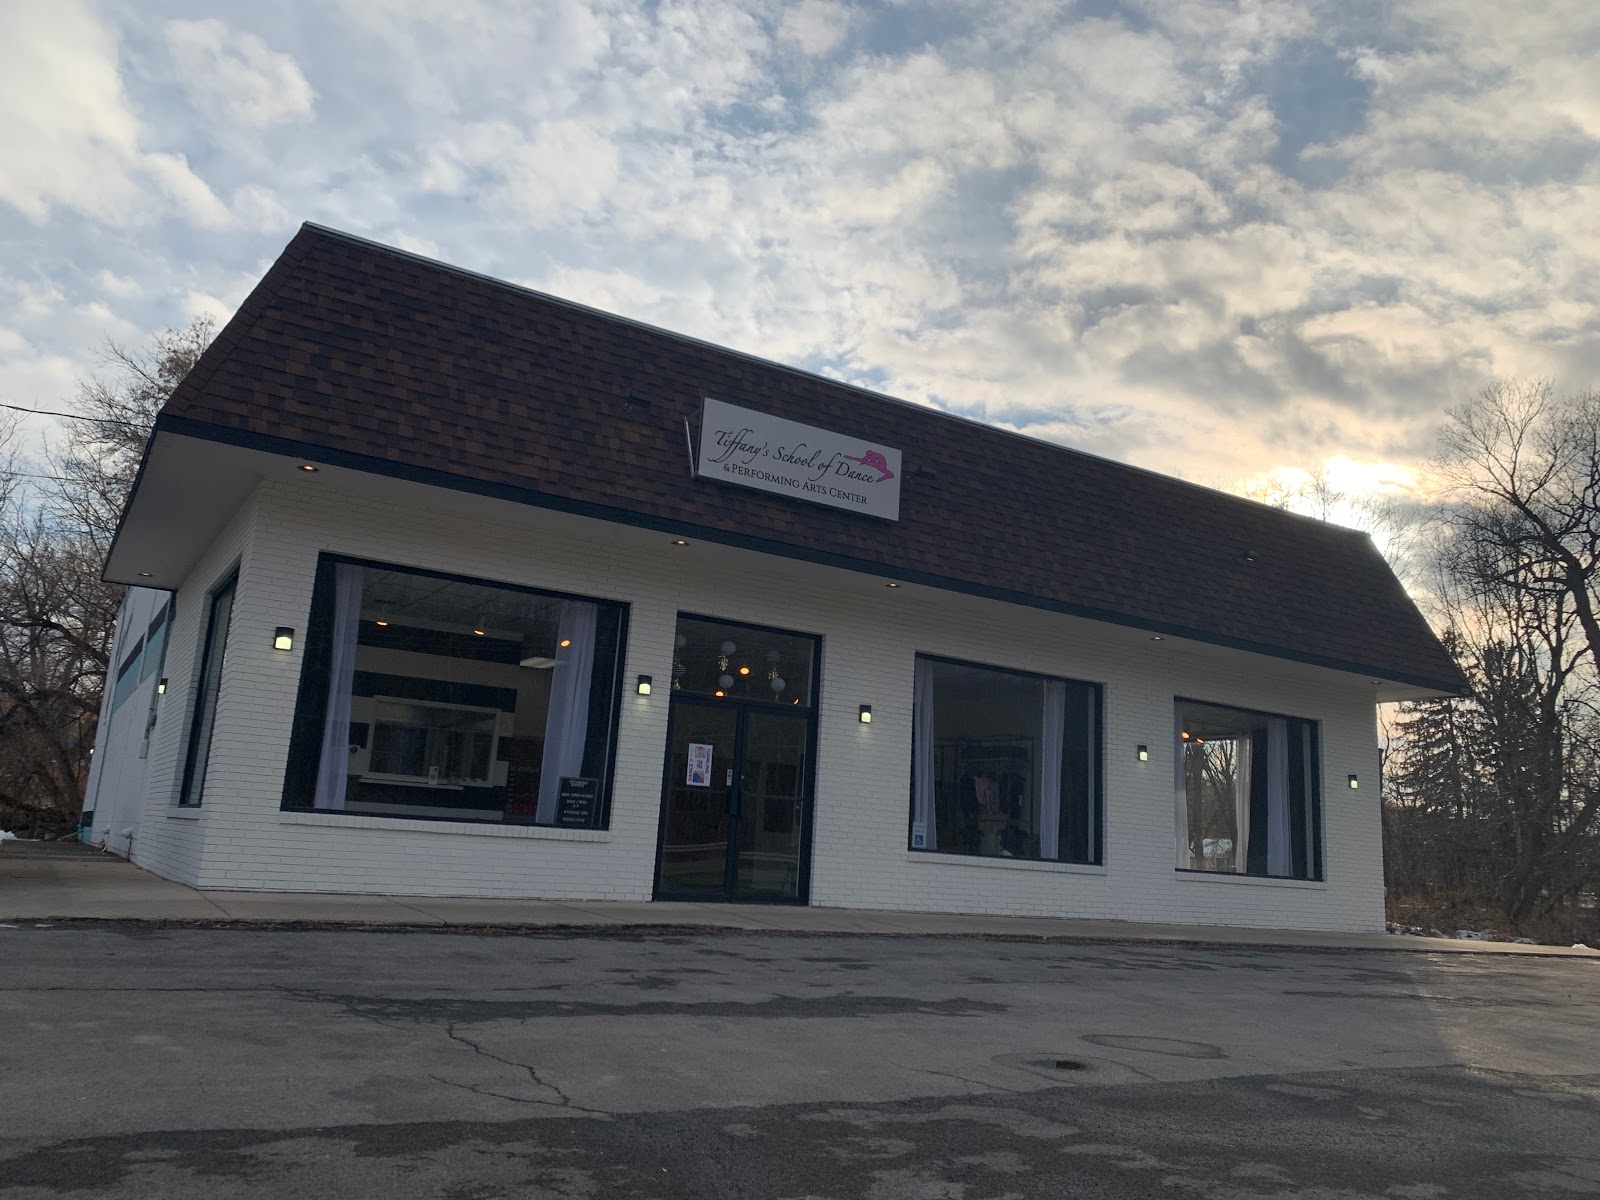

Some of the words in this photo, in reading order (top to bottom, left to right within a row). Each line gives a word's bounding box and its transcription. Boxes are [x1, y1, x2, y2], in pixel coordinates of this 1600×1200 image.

[707, 428, 770, 465] Tiffany's
[772, 443, 822, 468] School
[807, 452, 842, 482] of
[835, 460, 875, 484] Dance
[723, 463, 730, 472] &
[731, 463, 800, 489] PERFORMING
[802, 481, 827, 495] ARTS
[829, 487, 868, 505] CENTER
